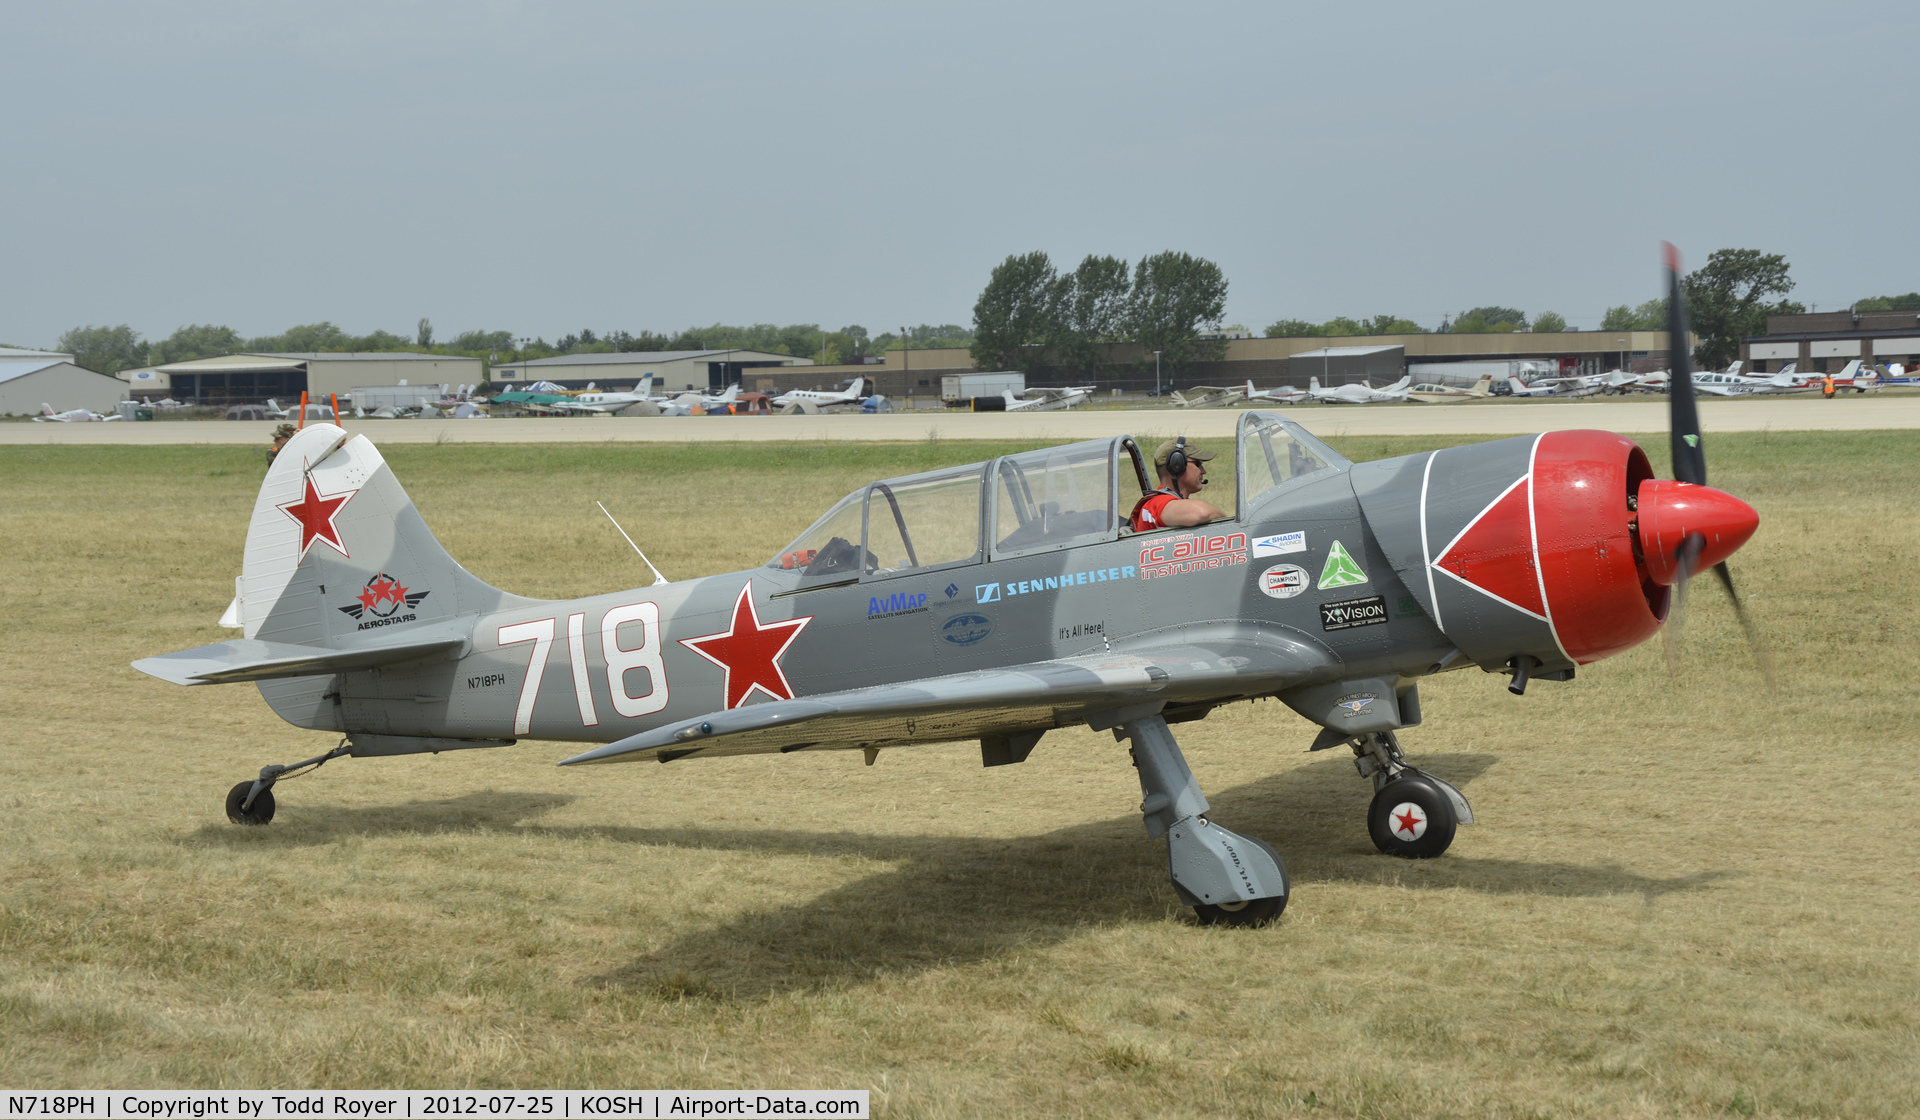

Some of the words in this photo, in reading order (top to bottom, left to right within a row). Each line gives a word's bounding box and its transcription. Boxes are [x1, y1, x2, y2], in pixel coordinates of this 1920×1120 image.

[1141, 536, 1175, 547] EQUIPPED
[1175, 533, 1194, 542] WITH
[1271, 532, 1302, 544] SHADIN
[1140, 545, 1164, 564] rc
[1172, 532, 1247, 558] allen
[1141, 552, 1248, 580] instruments
[1006, 565, 1136, 597] SENNHEISER
[1269, 575, 1298, 584] CHAMPION
[868, 611, 894, 621] SATELLITE
[894, 606, 929, 617] NAVIGATION
[1059, 627, 1070, 640] It's
[1072, 624, 1082, 637] All
[1084, 620, 1105, 635] Here!
[498, 601, 670, 736] 718
[467, 673, 506, 690] N718PH
